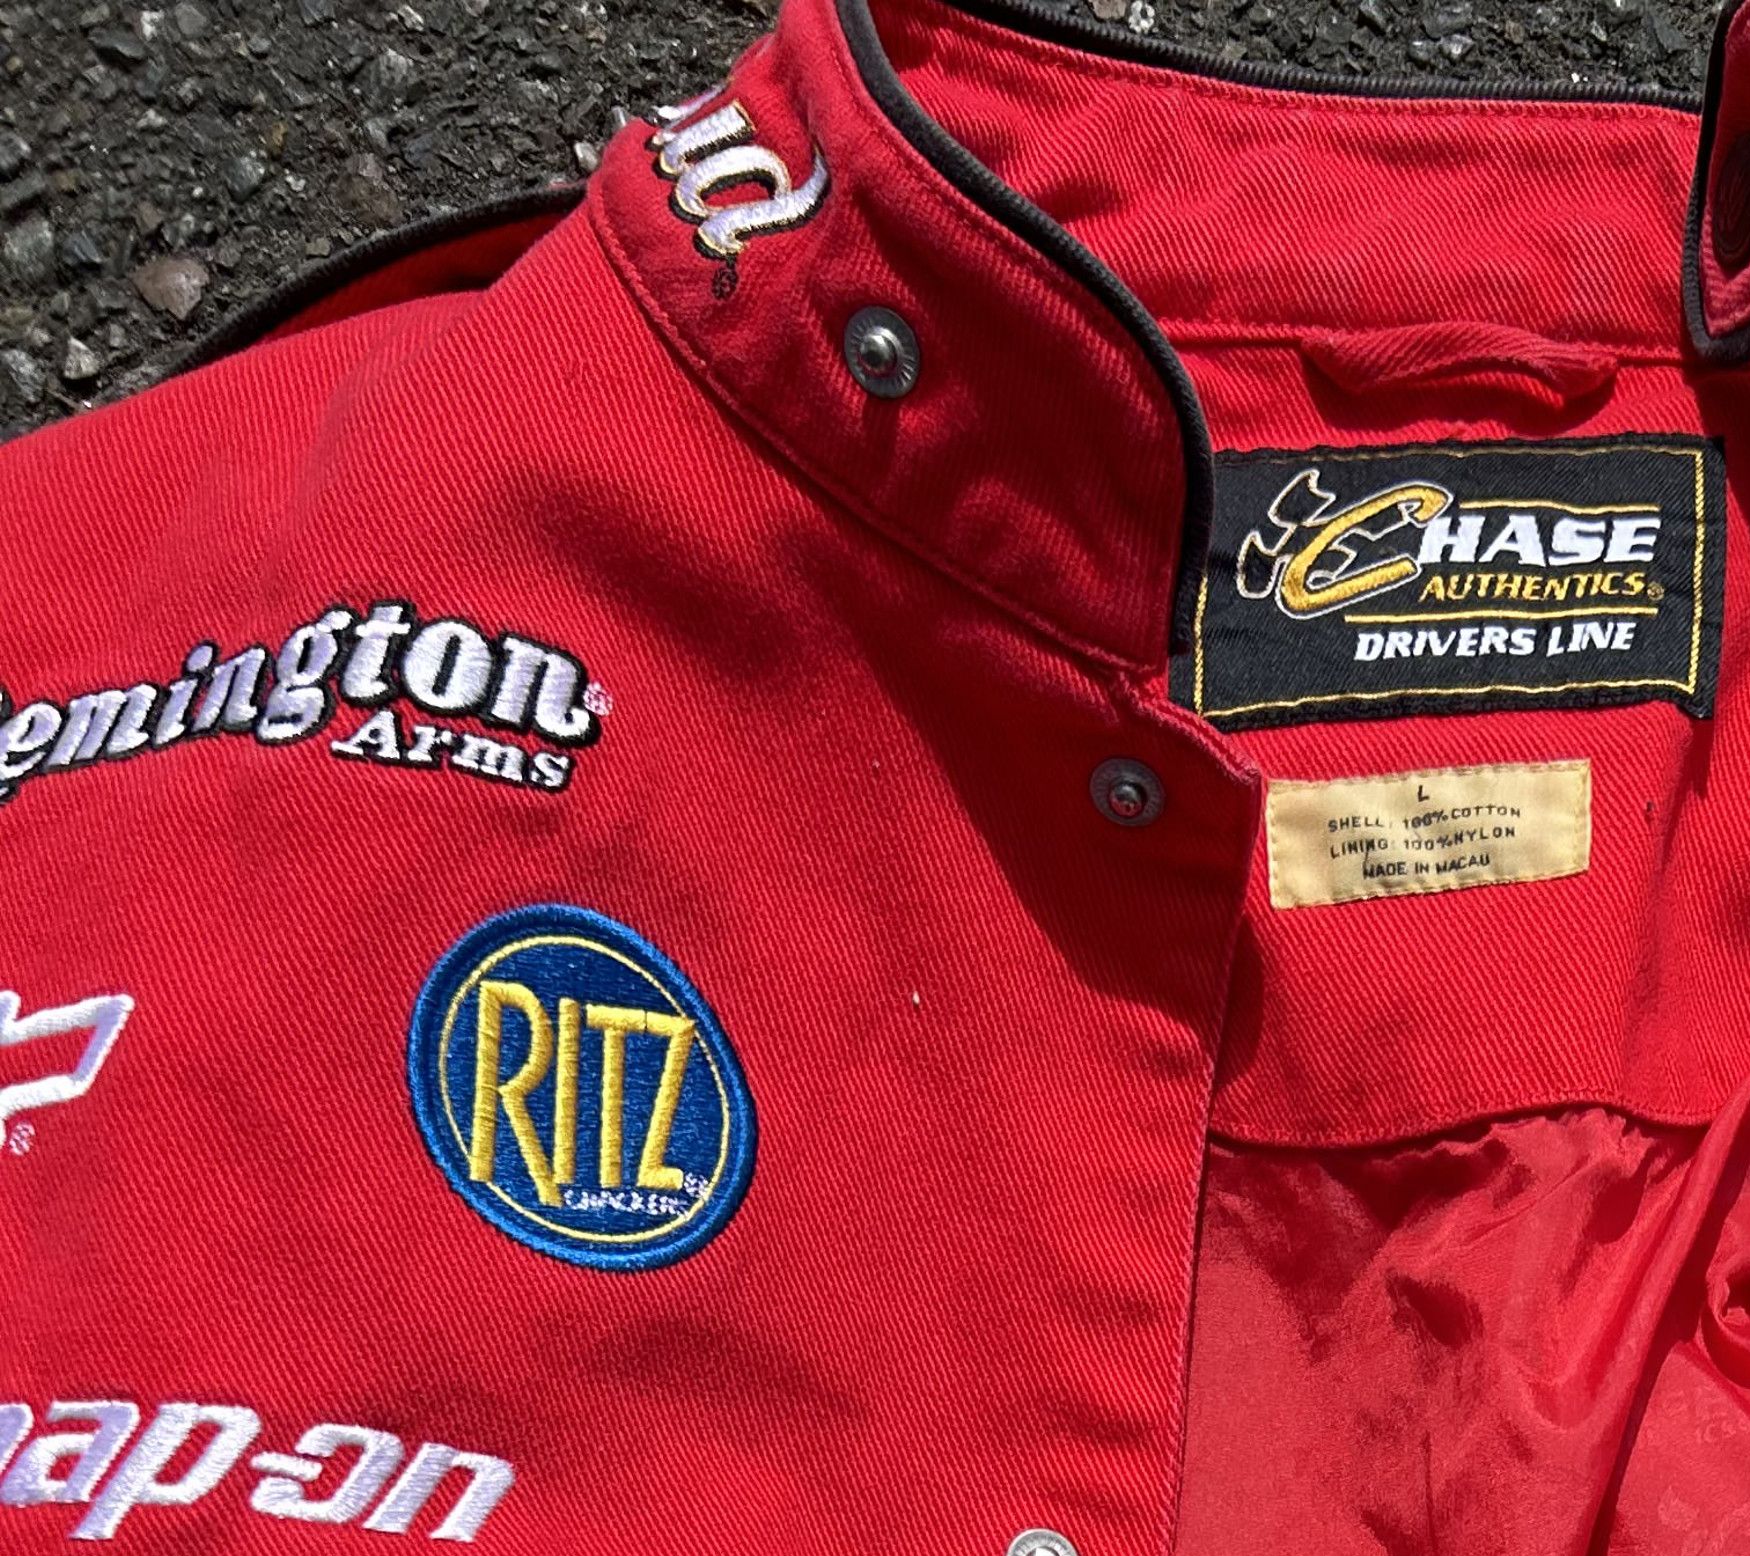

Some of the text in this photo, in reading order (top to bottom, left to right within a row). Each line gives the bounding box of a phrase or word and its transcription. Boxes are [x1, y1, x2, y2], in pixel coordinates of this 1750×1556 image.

[1418, 570, 1646, 602] AUTHENTICS
[1353, 620, 1637, 662] DRIVERS LINE
[0, 598, 600, 794] emington
[331, 705, 573, 794] Arms
[1415, 784, 1430, 802] L
[1361, 851, 1491, 880] MADE IN MACAU
[470, 979, 697, 1206] RITZ
